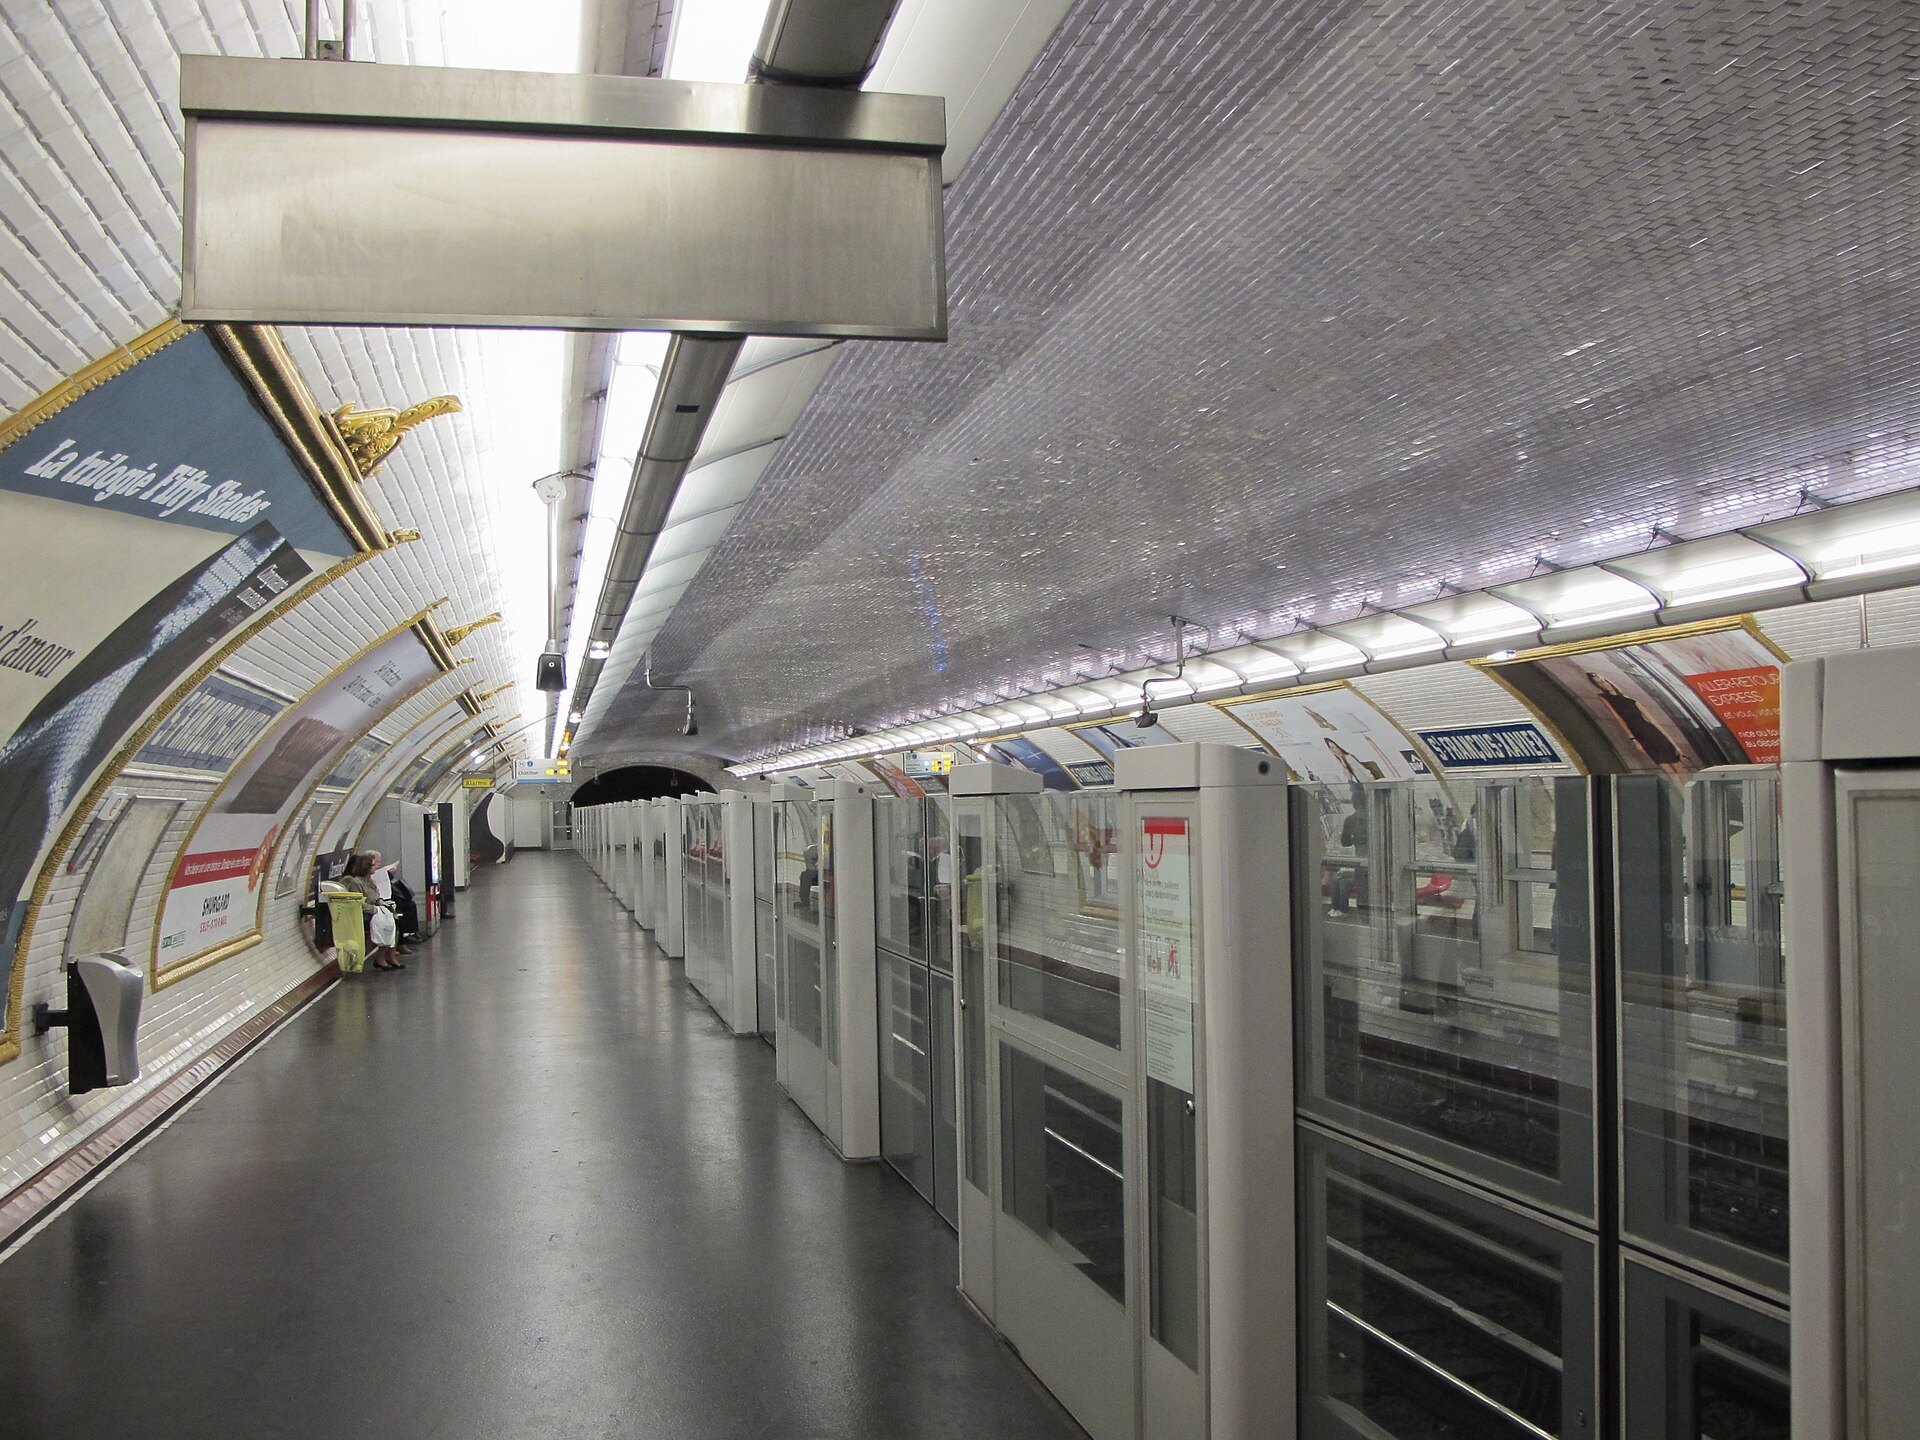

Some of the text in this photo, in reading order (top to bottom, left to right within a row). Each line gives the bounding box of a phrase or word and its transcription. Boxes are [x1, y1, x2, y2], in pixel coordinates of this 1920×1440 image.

[23, 438, 272, 523] La trilogie Fifty Shades
[1707, 690, 1764, 707] EXPRESS
